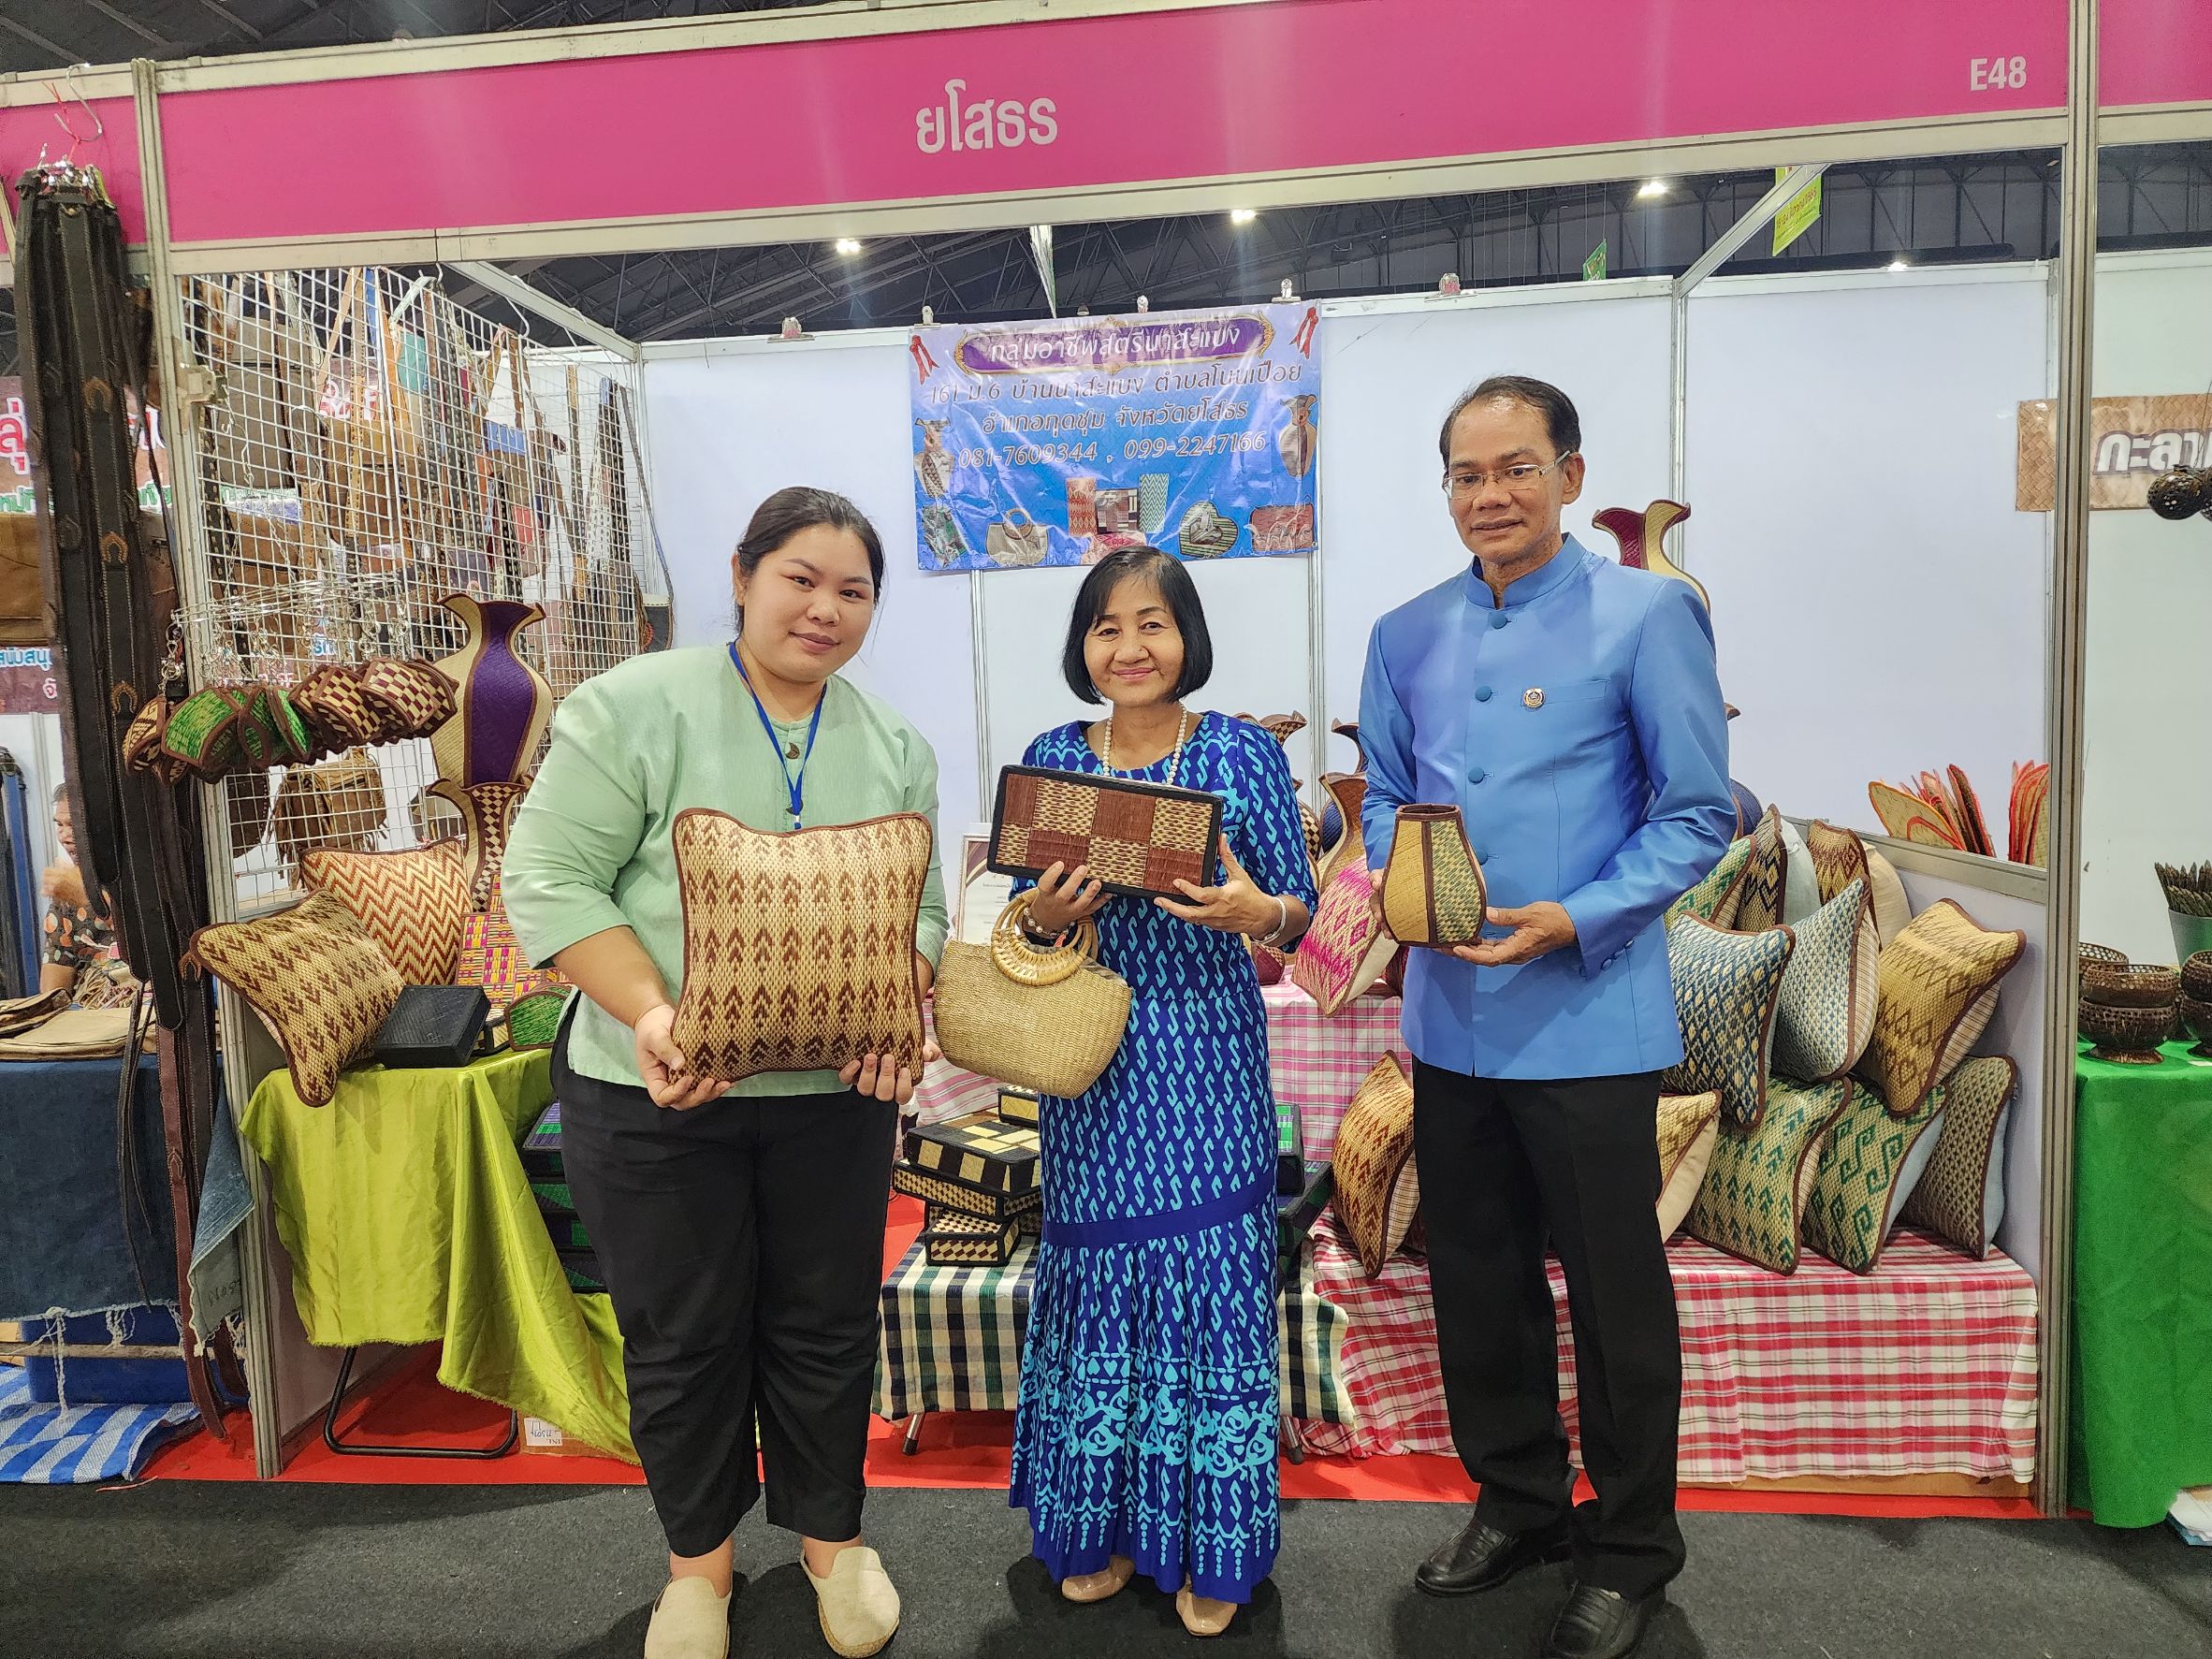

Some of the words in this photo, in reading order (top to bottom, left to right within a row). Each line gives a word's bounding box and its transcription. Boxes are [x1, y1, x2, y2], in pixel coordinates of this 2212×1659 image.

[1970, 55, 2027, 91] E48
[916, 79, 1058, 154] ยโสธร
[982, 408, 1105, 437] อำเภอกุดชุม
[1116, 396, 1248, 428] จังหวัดยโสธร
[958, 442, 1098, 468] 081-7609344
[1124, 430, 1267, 460] 099-2247166
